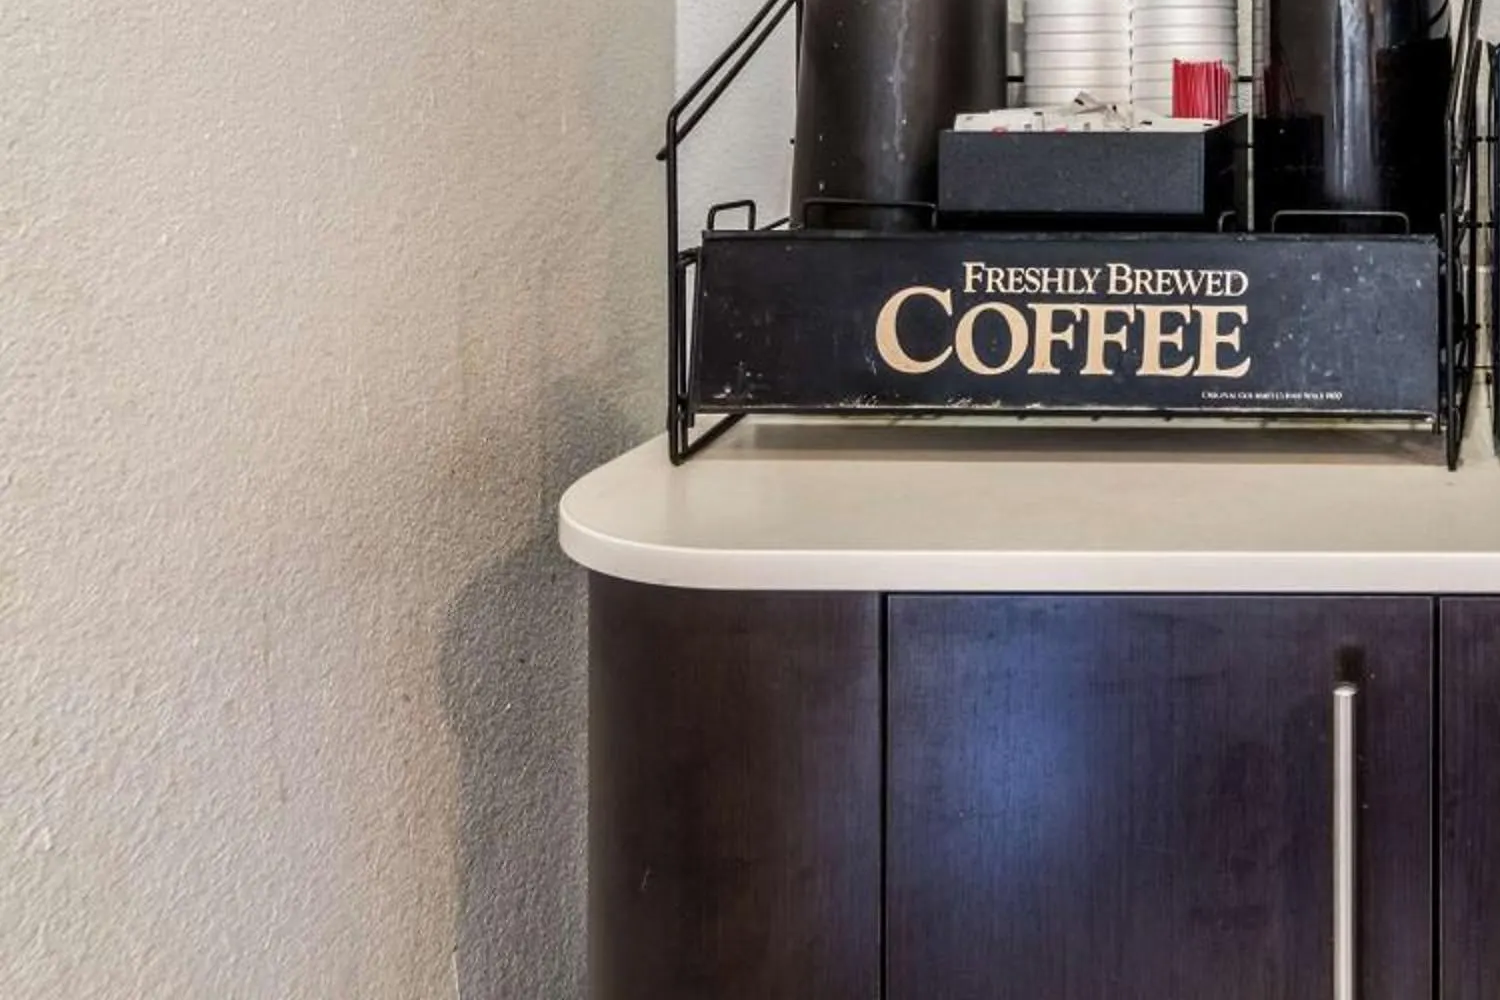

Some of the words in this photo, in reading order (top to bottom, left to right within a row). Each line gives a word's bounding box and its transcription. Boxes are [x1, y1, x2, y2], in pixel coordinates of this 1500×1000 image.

[962, 261, 1101, 294] FRESHLY
[1106, 262, 1249, 297] BREWED
[875, 286, 1251, 379] COFFEE
